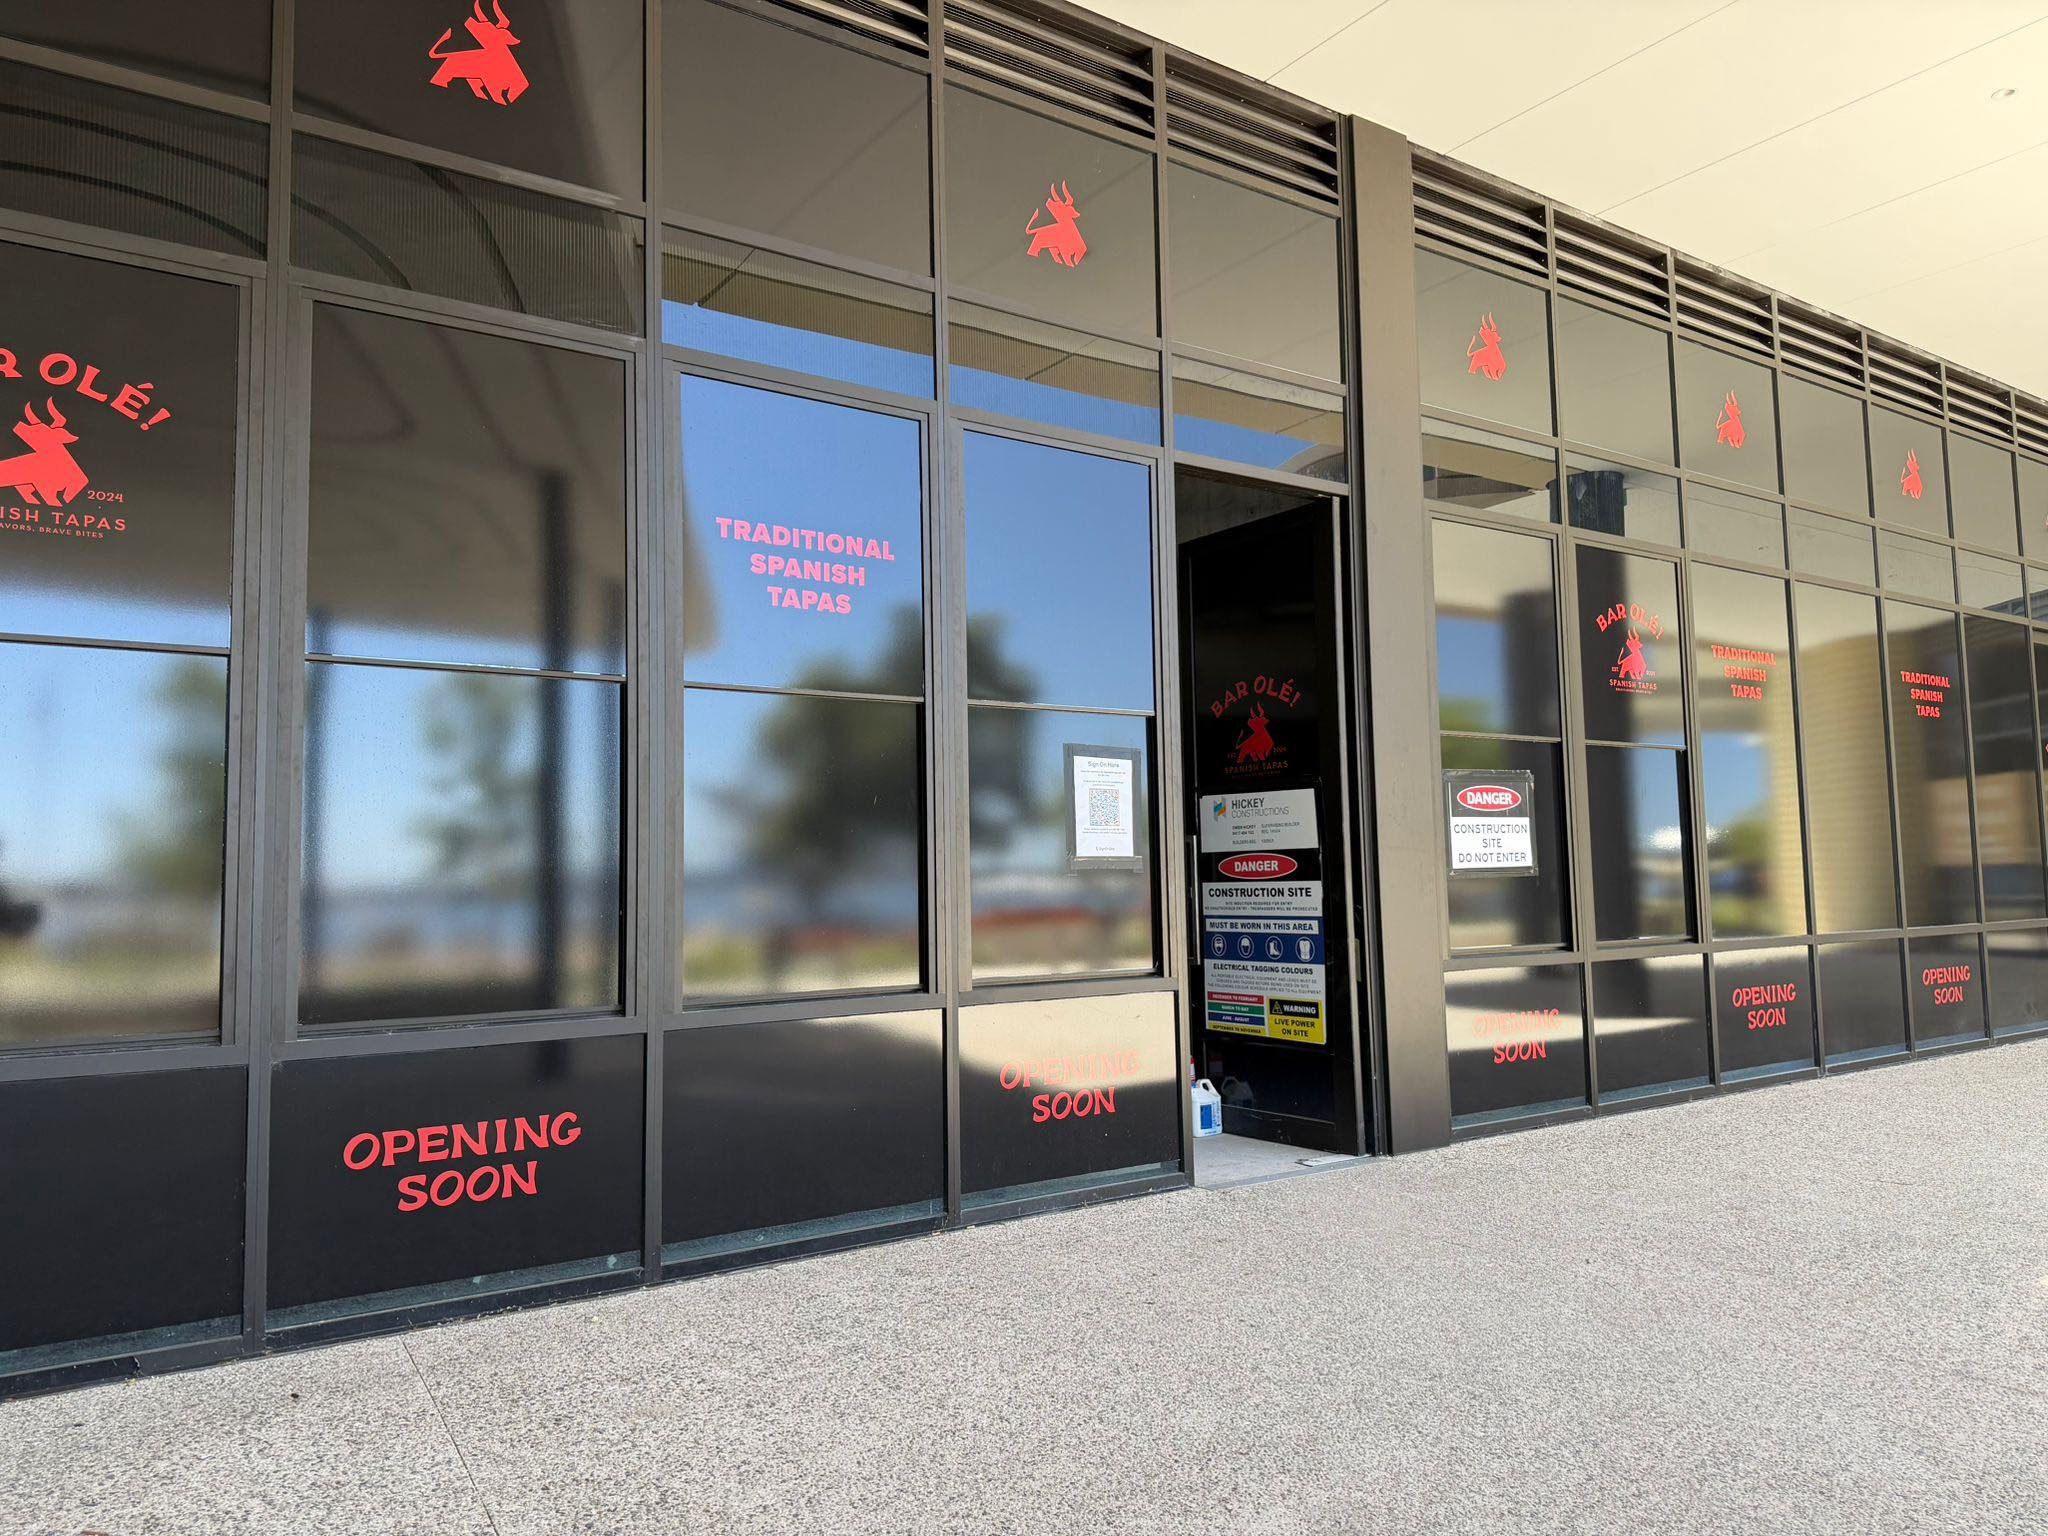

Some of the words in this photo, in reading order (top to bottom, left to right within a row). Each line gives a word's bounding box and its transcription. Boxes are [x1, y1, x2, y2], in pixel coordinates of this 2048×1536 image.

[39, 353, 171, 431] OLÉ!
[87, 490, 124, 503] 2024
[0, 506, 39, 522] ISH
[51, 511, 127, 531] TAPAS
[39, 527, 72, 535] BRAVE
[75, 530, 104, 539] BITES
[716, 516, 895, 561] TRADITIONAL
[750, 553, 866, 587] SPANISH
[767, 585, 852, 615] TAPAS
[1596, 603, 1627, 632] BAR
[1629, 603, 1665, 640] OLÉ!
[1711, 645, 1776, 666] TRADITIONAL
[1724, 664, 1767, 682] SPANISH
[1901, 671, 1951, 688] TRADITIONAL
[1609, 679, 1637, 688] SPANISH
[1638, 681, 1658, 690] TAPAS
[1731, 684, 1763, 700] TAPAS
[1210, 680, 1249, 719] BAR
[1254, 674, 1301, 708] OLÉ!
[1911, 688, 1943, 702] SPANISH
[1916, 704, 1941, 718] TAPAS
[1231, 798, 1265, 809] HICKEY
[1467, 791, 1513, 805] DANGER
[1231, 806, 1290, 819] CONSTRUCTIONS
[1453, 824, 1528, 834] CONSTRUCTION
[1482, 838, 1503, 848] SITE
[1234, 860, 1279, 872] DANGER
[1458, 853, 1473, 863] DO
[1475, 853, 1494, 863] NOT
[1496, 852, 1527, 862] ENTER
[1208, 887, 1285, 898] CONSTRUCTION
[1287, 887, 1312, 897] SITE
[1209, 921, 1228, 929] MUST
[1240, 922, 1261, 930] WORN
[1273, 923, 1291, 931] THIS
[1292, 923, 1314, 931] AREA
[1213, 963, 1249, 972] ELECTRICAL
[1251, 965, 1280, 973] TAGGING
[1281, 966, 1314, 975] COLOURS
[1922, 965, 1971, 986] OPENING
[1732, 982, 1797, 1008] OPENING
[1934, 986, 1964, 1006] SOON
[1283, 1005, 1317, 1014] WARNING
[1274, 1018, 1290, 1026] LIVE
[1290, 1019, 1316, 1029] POWER
[1473, 1008, 1562, 1039] OPENING
[1747, 1007, 1787, 1030] SOON
[1281, 1028, 1292, 1036] ON
[1293, 1029, 1309, 1038] SITE
[1493, 1040, 1547, 1064] SOON
[1000, 1050, 1147, 1091] OPENING
[1032, 1086, 1116, 1123] SOON
[343, 1111, 583, 1170] OPENING
[397, 1160, 538, 1212] SOON
